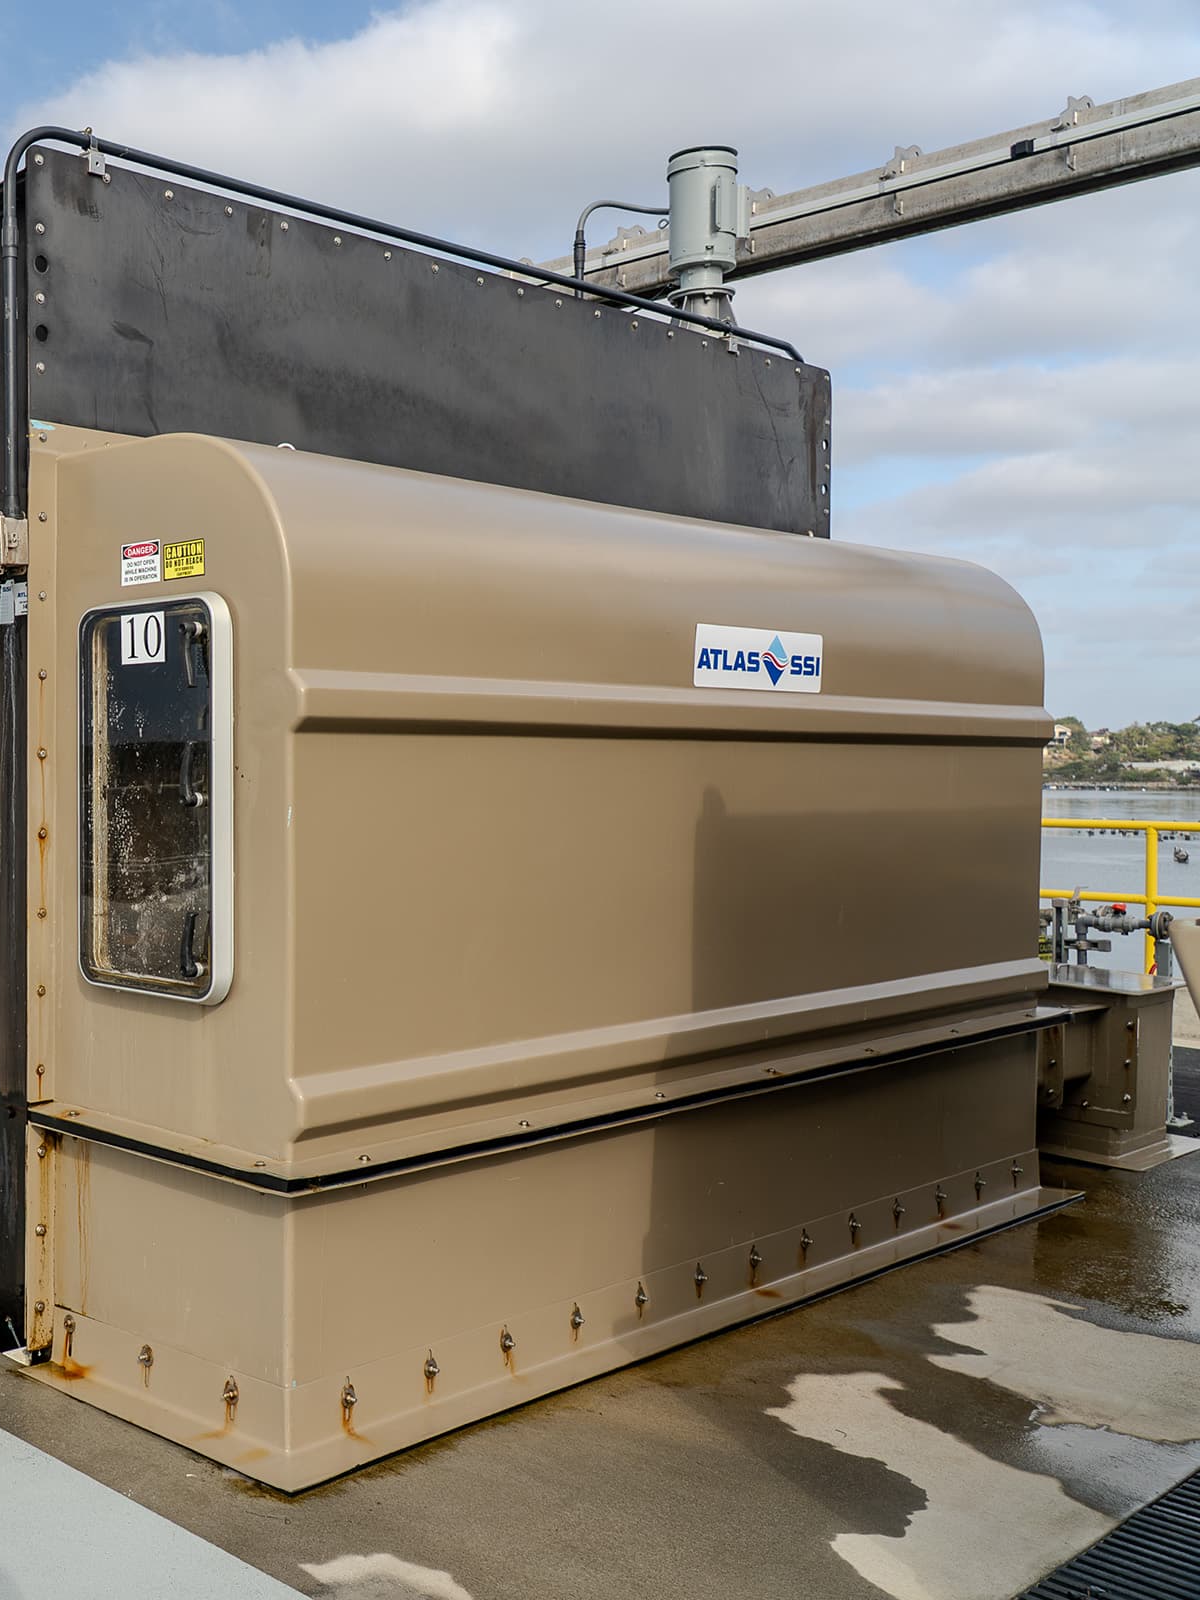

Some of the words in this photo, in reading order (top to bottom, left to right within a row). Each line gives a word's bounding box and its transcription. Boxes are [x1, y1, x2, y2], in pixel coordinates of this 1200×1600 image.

[127, 545, 154, 557] DANGER
[166, 542, 202, 559] CAUTION
[127, 615, 161, 659] 10
[697, 647, 760, 672] ATLAS
[790, 655, 820, 676] SSI
